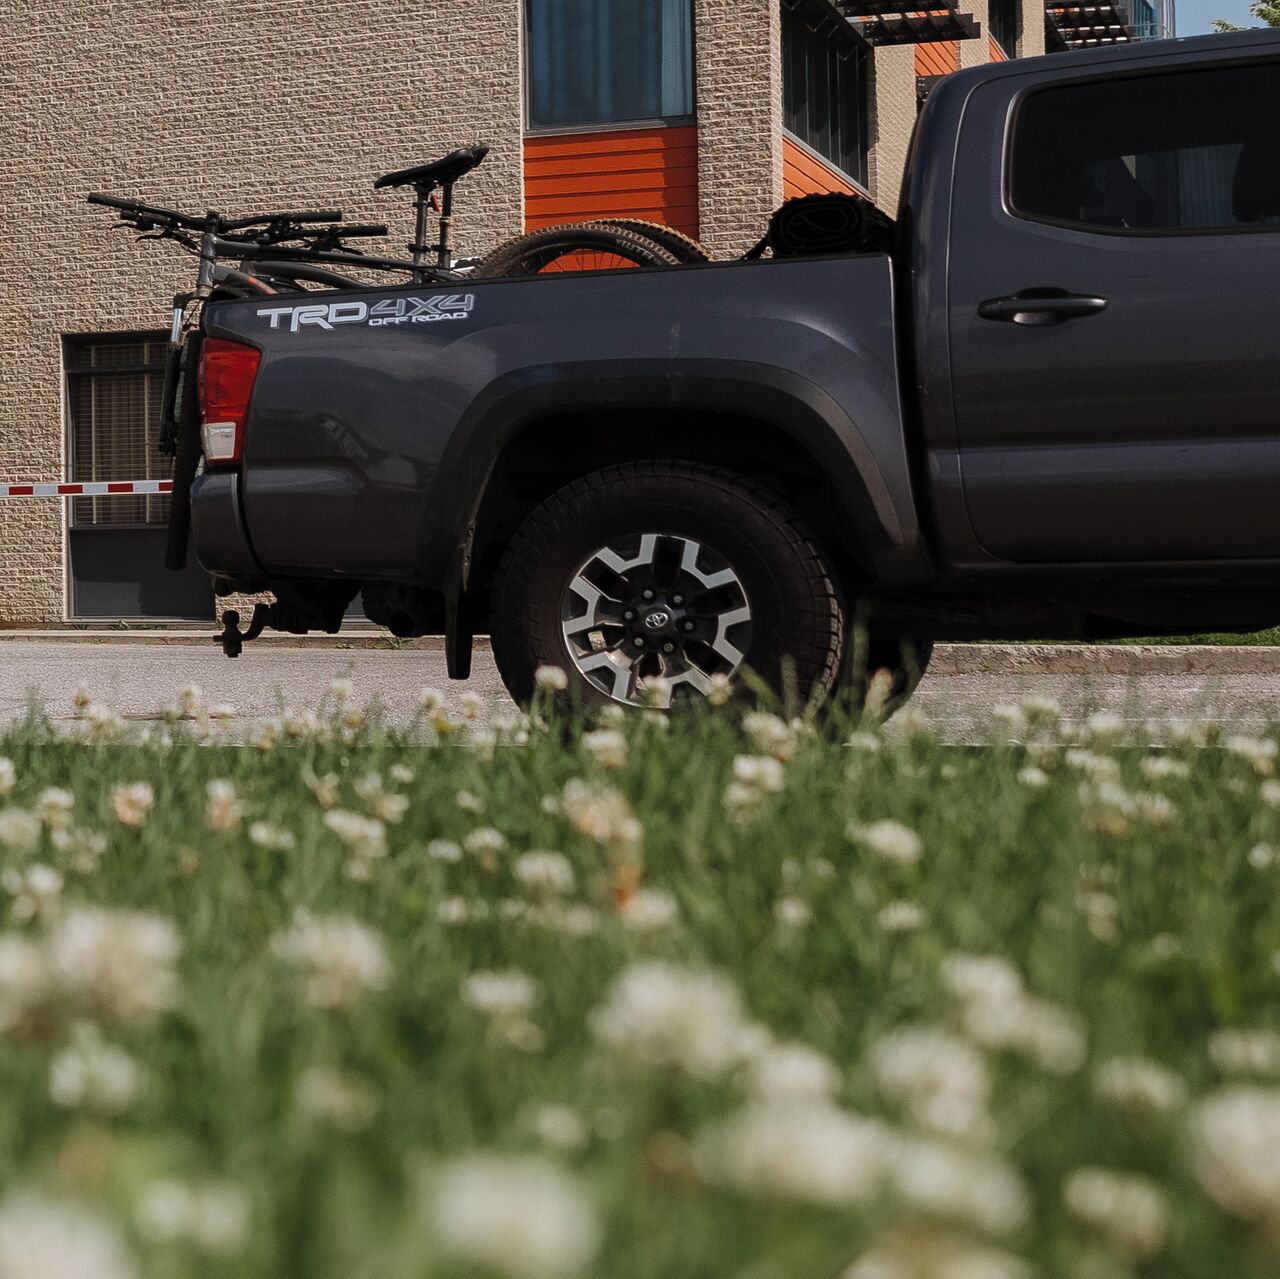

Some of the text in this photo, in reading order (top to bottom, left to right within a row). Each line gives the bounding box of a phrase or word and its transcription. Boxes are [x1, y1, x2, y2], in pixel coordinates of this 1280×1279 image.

[257, 301, 368, 333] TRD
[368, 311, 468, 327] OFF ROAD
